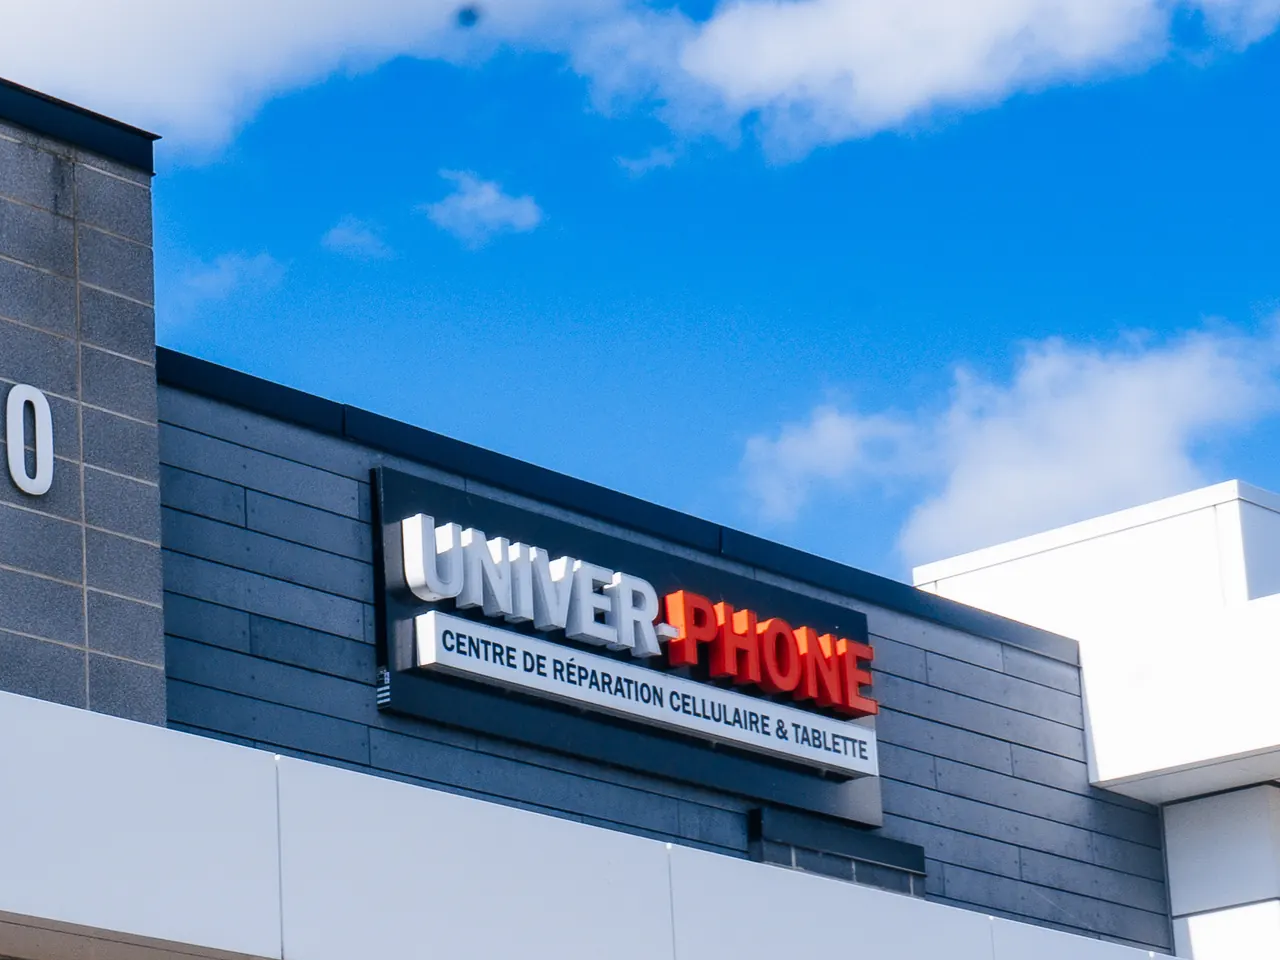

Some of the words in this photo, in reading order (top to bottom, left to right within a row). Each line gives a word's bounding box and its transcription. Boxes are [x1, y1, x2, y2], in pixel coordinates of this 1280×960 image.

[401, 512, 879, 719] UNIVER-PHONE
[442, 629, 517, 669] CENTRE
[523, 651, 547, 677] DE
[553, 657, 664, 708] RÉPARATION
[669, 690, 771, 736] CELLULAIRE
[775, 719, 789, 741] &
[792, 723, 869, 761] TABLETTE
